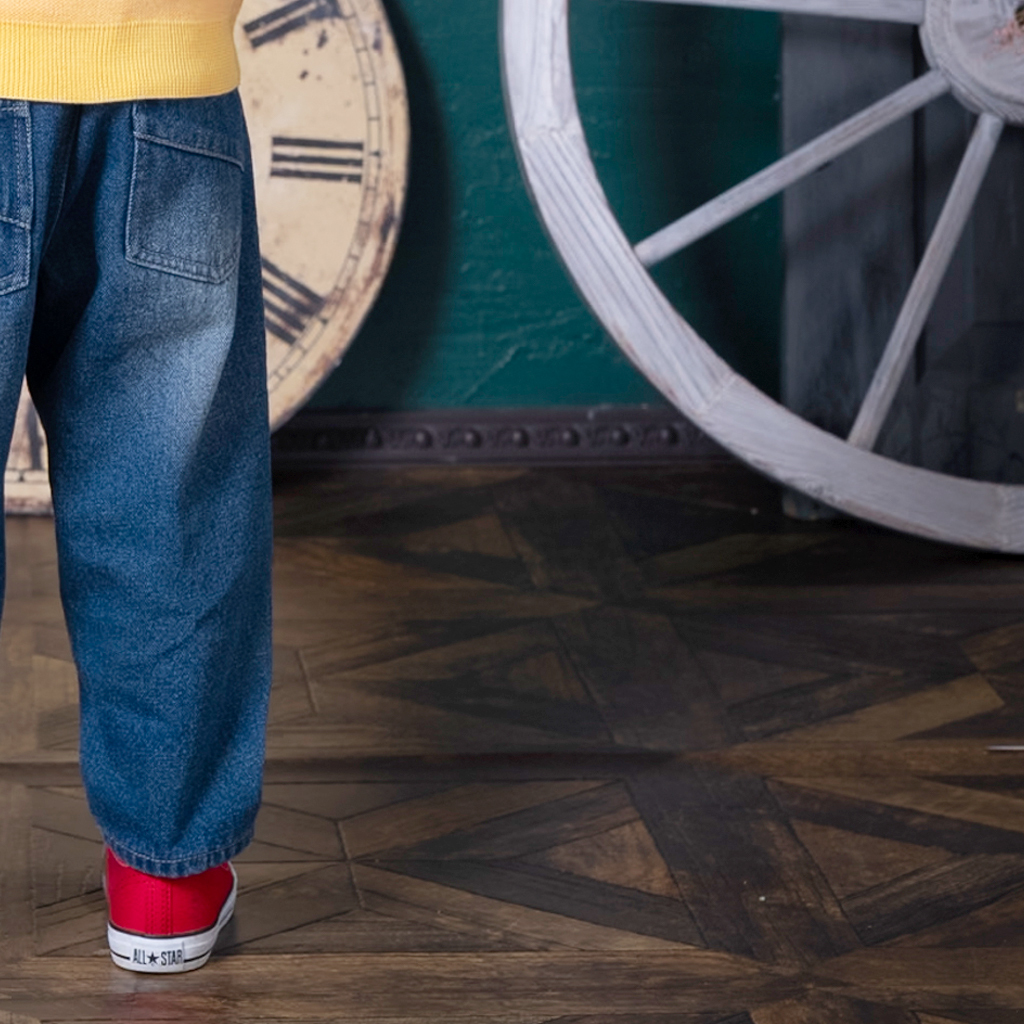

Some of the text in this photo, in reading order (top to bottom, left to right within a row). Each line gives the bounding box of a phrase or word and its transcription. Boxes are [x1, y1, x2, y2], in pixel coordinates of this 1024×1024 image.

[270, 136, 364, 184] III
[132, 948, 183, 966] ALL STAR
